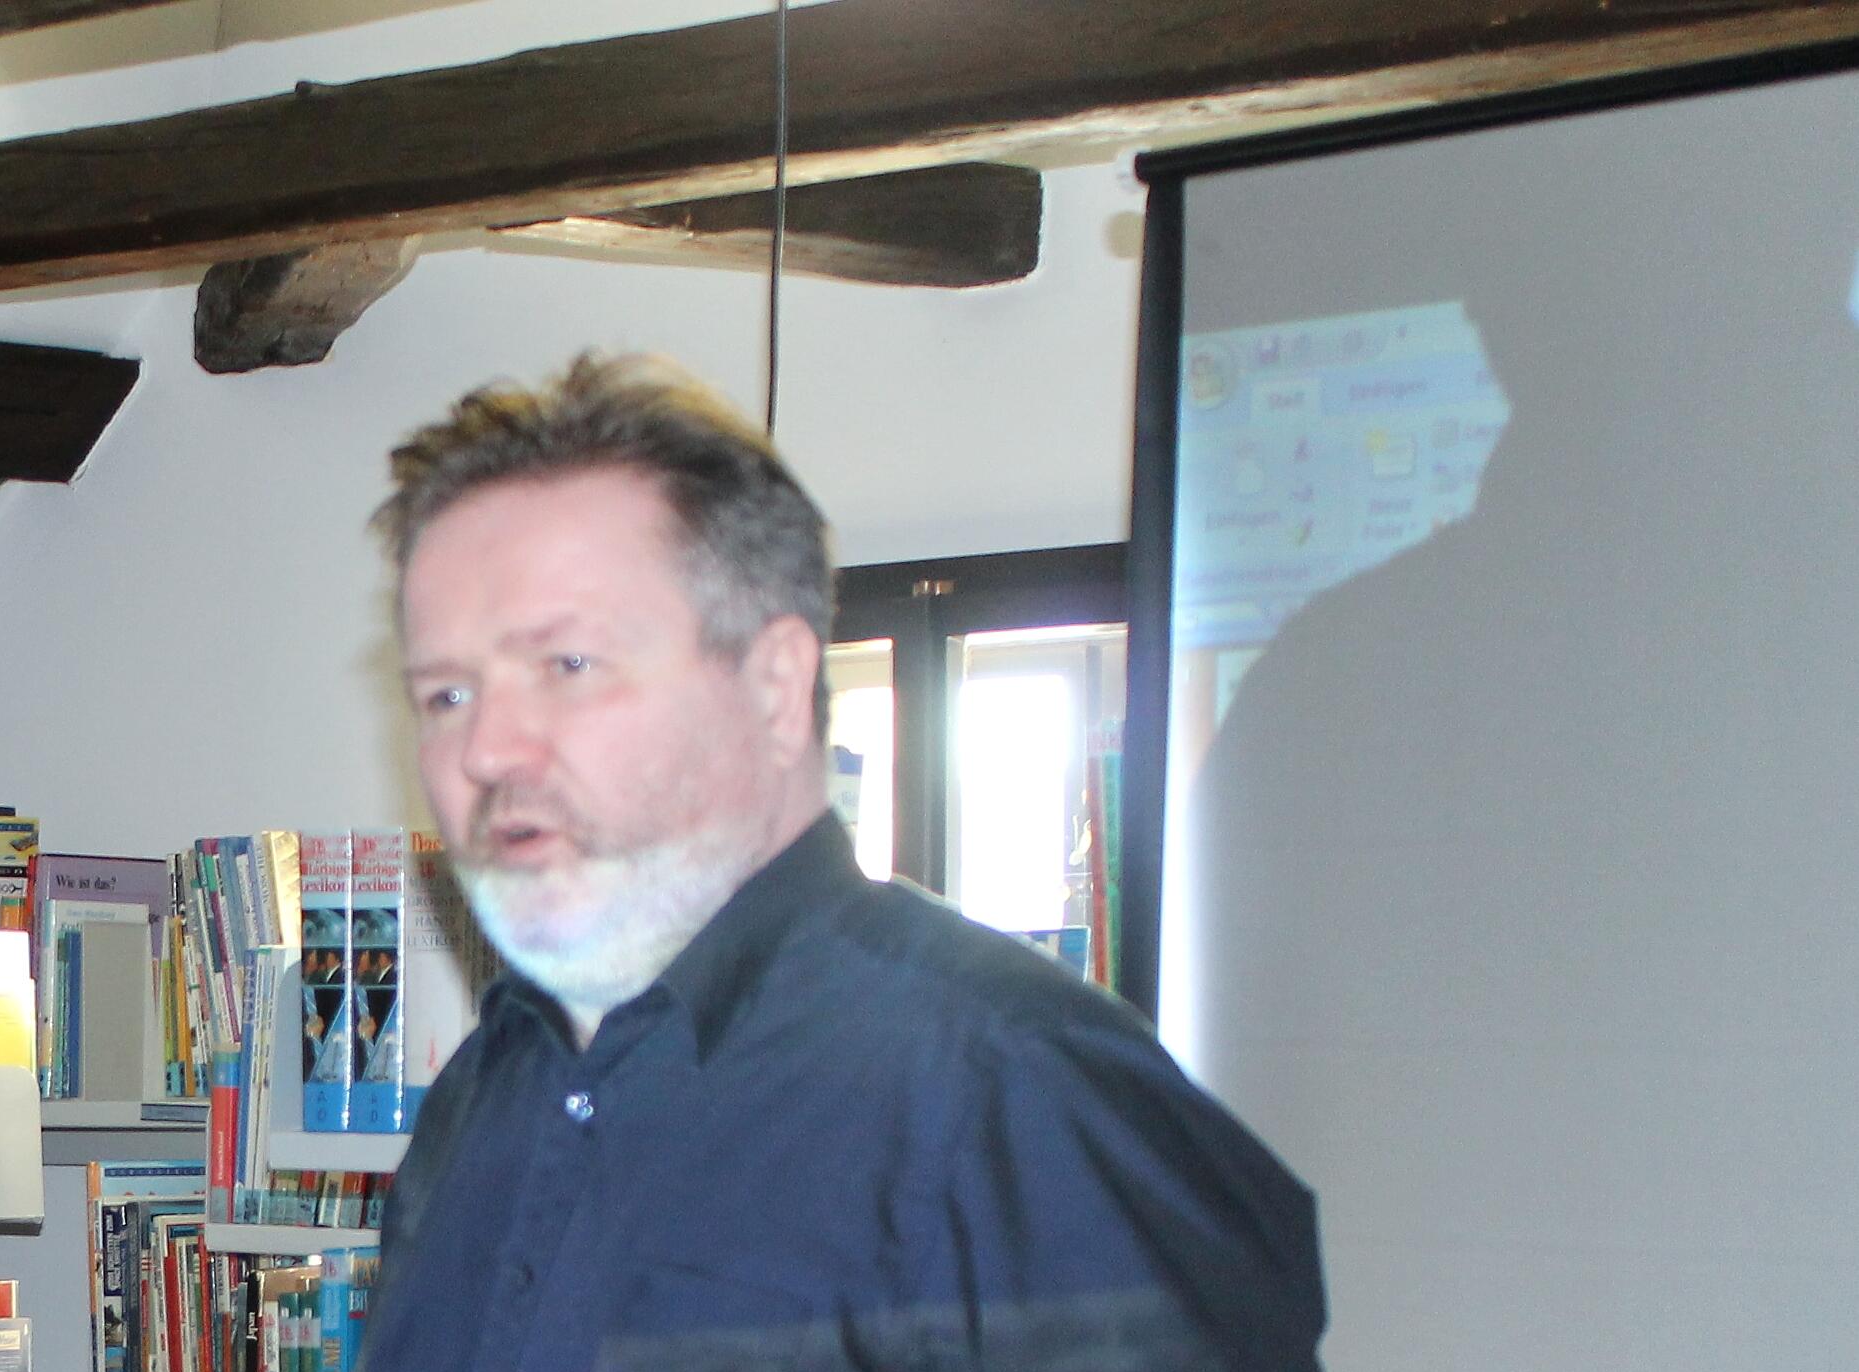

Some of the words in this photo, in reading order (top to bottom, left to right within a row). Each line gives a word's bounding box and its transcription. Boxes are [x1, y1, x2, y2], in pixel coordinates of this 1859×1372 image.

[56, 875, 73, 889] Wie
[79, 876, 90, 889] ist
[95, 877, 117, 891] das?
[246, 1312, 258, 1340] Japan
